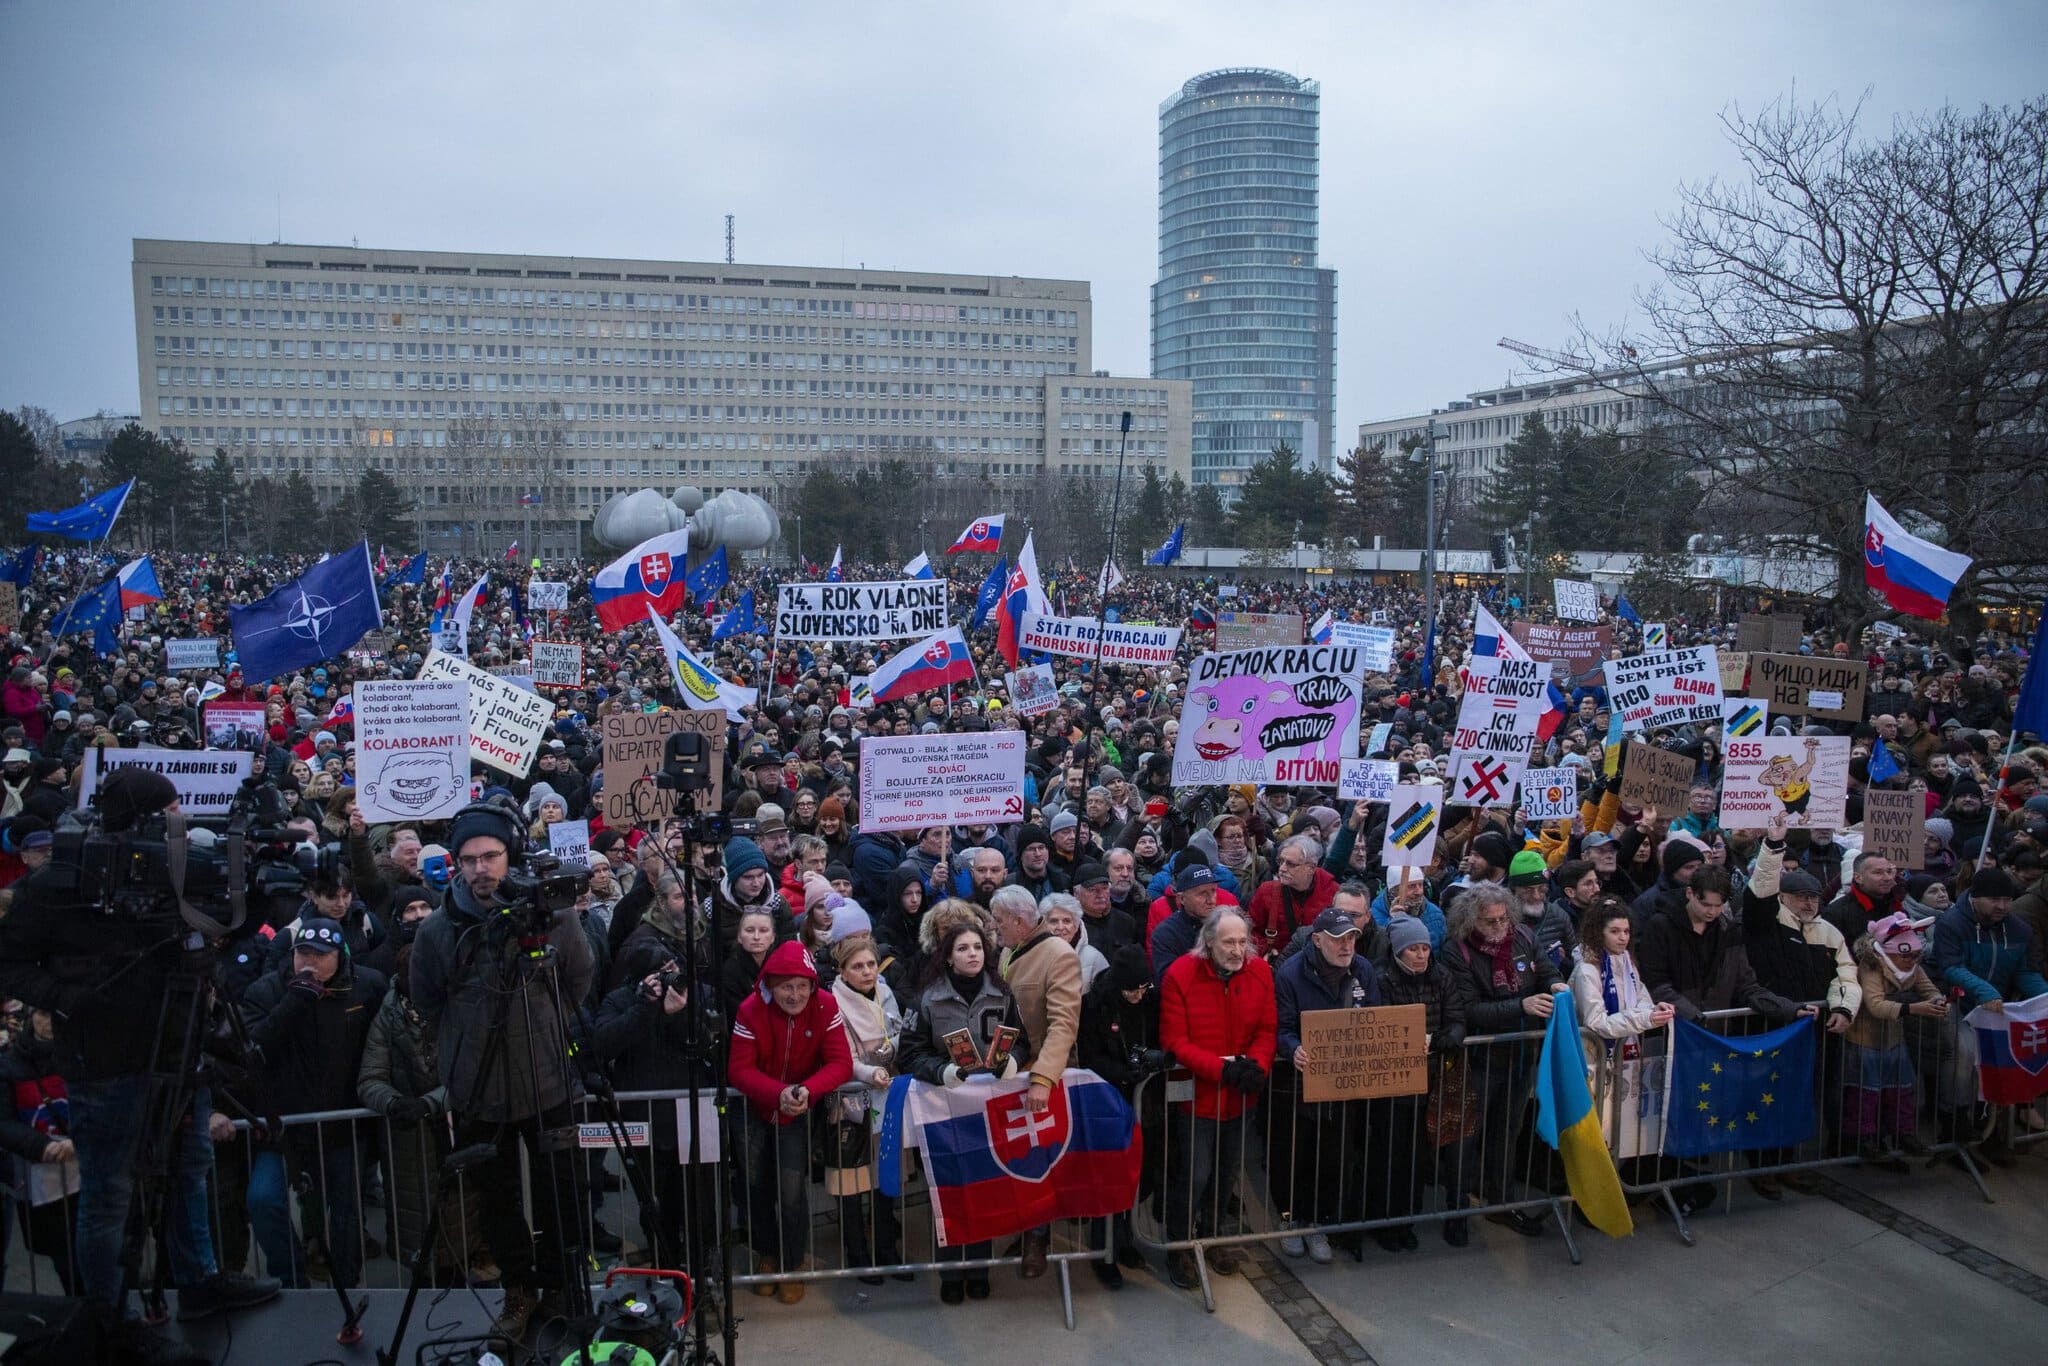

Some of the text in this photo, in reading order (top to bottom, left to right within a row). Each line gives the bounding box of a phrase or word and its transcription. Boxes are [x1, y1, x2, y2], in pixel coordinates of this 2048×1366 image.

[785, 583, 944, 611] 14. ROK VLÁDNE
[779, 609, 944, 636] SLOVENSKO JE NA DNE
[1036, 619, 1071, 636] ŠTÁT
[1530, 628, 1597, 640] RUSKÝ AGENT
[541, 645, 573, 658] NEMÁM
[1025, 633, 1091, 655] PRORUSKÍ
[1534, 648, 1561, 656] ADOLFA
[1564, 650, 1591, 658] PUTINA
[1617, 654, 1671, 671] MOHLI
[1677, 649, 1700, 661] BY
[533, 658, 579, 672] JEDINÝ DÔVOD
[1200, 648, 1357, 680] DEMOKRACIU
[1500, 660, 1537, 679] NAŠA
[536, 671, 547, 681] TU
[1616, 660, 1706, 684] SEM PRÍSŤ
[1762, 658, 1860, 690] ФИЦО, ИДИ
[363, 684, 375, 692] Ak
[378, 683, 403, 691] niečo
[406, 682, 434, 692] vyzerá
[433, 658, 460, 676] Ale
[468, 672, 495, 692] nás
[502, 687, 518, 702] tu
[522, 696, 544, 717] je,
[1296, 679, 1349, 703] KRAVU
[1467, 675, 1545, 698] NEČINNOSŤ
[1612, 677, 1715, 711] FICO BLAHA
[363, 694, 414, 702] kolaborant,
[1654, 694, 1696, 706] ŠUKYNO
[363, 702, 460, 713] chodí ako kolaborant,
[479, 697, 487, 707] v
[488, 700, 544, 732] januári
[363, 717, 391, 725] kváka
[394, 716, 411, 724] ako
[1491, 712, 1516, 731] ICH
[1623, 704, 1720, 728] ALIŇÁK RICHTER KÉRY
[364, 728, 372, 737] je
[483, 718, 528, 747] Ficov
[608, 713, 717, 738] SLOVENSKO
[1261, 716, 1334, 748] ZAMATOVÚ
[364, 736, 454, 751] KOLABORANT
[1454, 727, 1534, 752] ZLOČINNOSŤ
[875, 747, 914, 756] GOTWALD
[957, 743, 987, 752] MEČIAR
[1728, 744, 1762, 758] 855
[155, 762, 164, 773] A
[166, 760, 218, 774] ZÁHORIE
[221, 761, 237, 774] SÚ
[1360, 763, 1374, 772] RF
[1632, 747, 1656, 774] VRAJ
[864, 760, 872, 788] MAPA
[927, 764, 966, 774] SLOVÁCI
[1237, 759, 1267, 781] NA
[1276, 758, 1338, 782] BITÚNO
[1524, 769, 1573, 779] SLOVENSKO
[886, 773, 1005, 787] BOJUJTE ZA DEMOKRACIU
[1524, 778, 1534, 787] JE
[194, 792, 236, 805] EURÓP
[874, 790, 901, 800] HORNÉ
[904, 790, 944, 799] UHORSKO
[976, 786, 1014, 794] UHORSKO
[1525, 786, 1573, 804] STOP
[1724, 790, 1768, 799] POLITICKÝ
[1868, 793, 1914, 808] NECHCEME
[1525, 802, 1573, 817] RUSKU
[1722, 802, 1771, 810] DÔCHODOK
[879, 809, 1000, 824] ХОРОШО ДРУЗЬЯ Царь ПУТИН
[555, 844, 586, 856] MY SME
[1879, 847, 1909, 862] PLYN
[1308, 1030, 1324, 1043] MY
[1326, 1027, 1352, 1042] VIEME
[1355, 1026, 1374, 1040] KTO
[1378, 1025, 1399, 1039] STE
[1311, 1046, 1329, 1061] STE
[1310, 1062, 1328, 1075] STE
